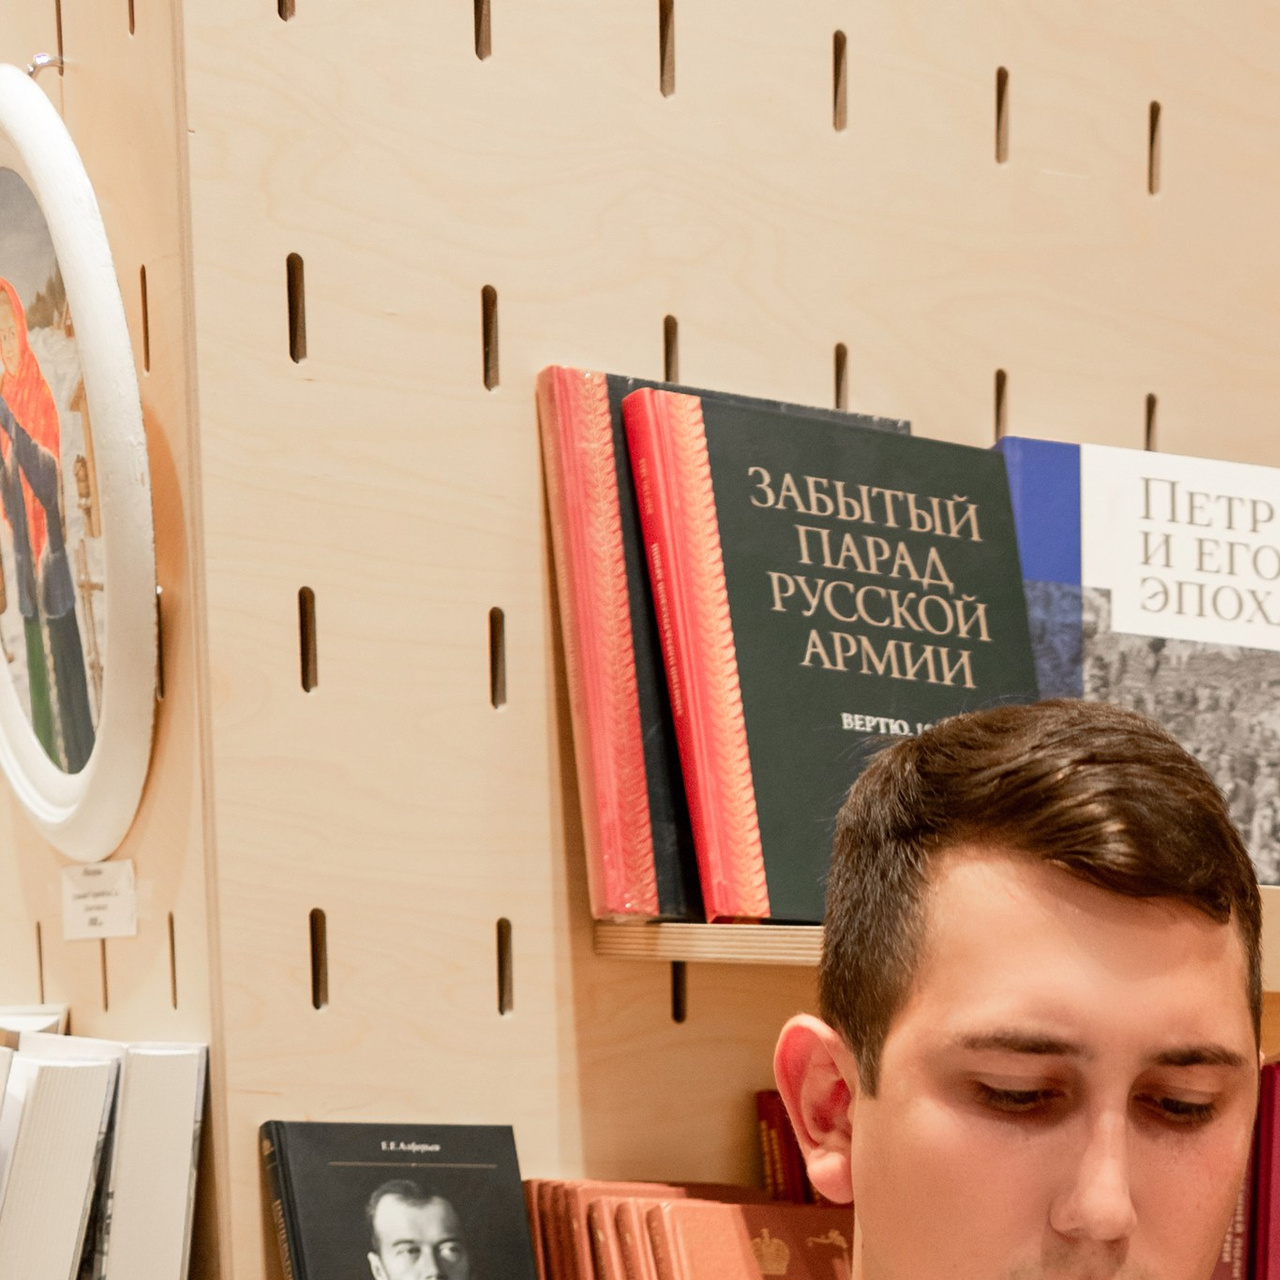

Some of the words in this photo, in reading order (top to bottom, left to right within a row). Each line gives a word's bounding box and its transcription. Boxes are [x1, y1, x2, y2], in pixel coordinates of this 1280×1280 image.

[747, 466, 983, 542] ЗАБЫТЫЙ
[1140, 476, 1275, 534] ПЕТР
[795, 524, 955, 592] ПАРАД
[1140, 531, 1173, 569] И
[766, 571, 993, 642] РУССКОЙ
[800, 630, 977, 689] АРМИИ
